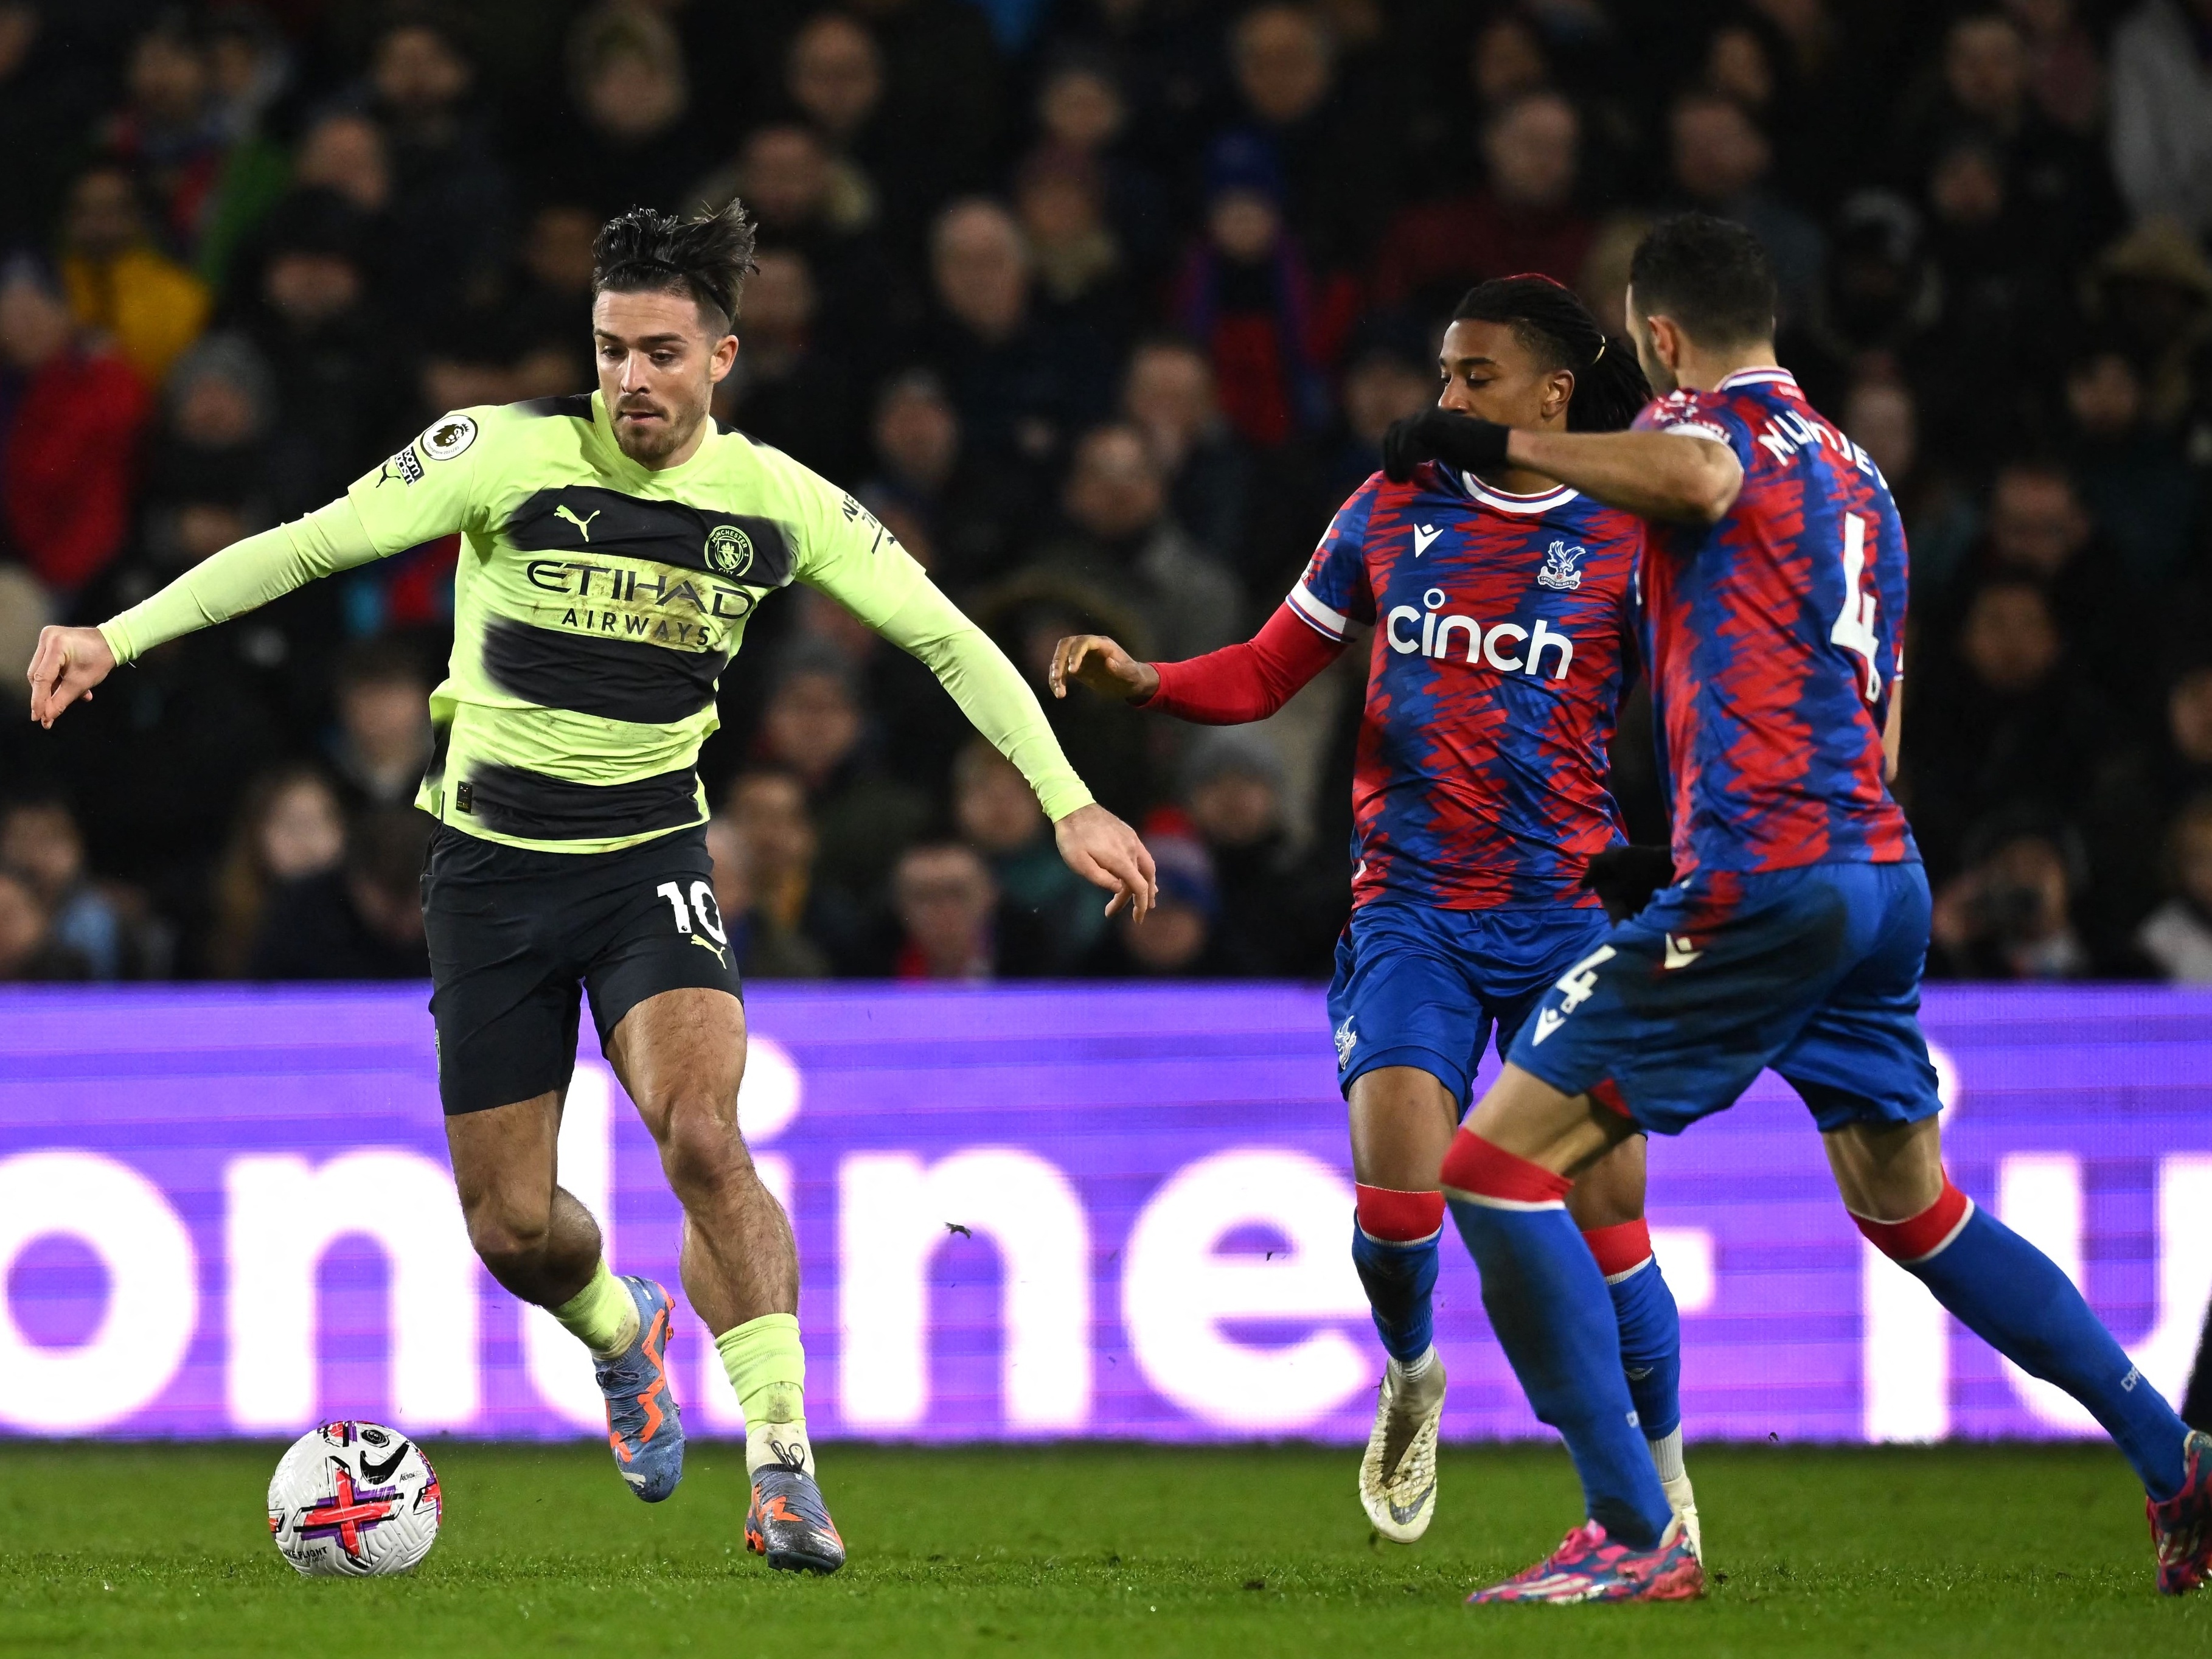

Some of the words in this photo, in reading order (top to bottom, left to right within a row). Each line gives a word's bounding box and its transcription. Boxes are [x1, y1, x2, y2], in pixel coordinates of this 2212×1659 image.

[395, 454, 415, 487] acism
[404, 445, 421, 476] oom
[527, 560, 754, 619] ETIHAD
[1541, 577, 1556, 586] CRYSTAL
[1831, 511, 1880, 703] 4
[562, 608, 711, 646] AIRWAYS
[1387, 588, 1573, 680] cinch
[657, 880, 728, 945] 10
[1556, 944, 1617, 1015] 4
